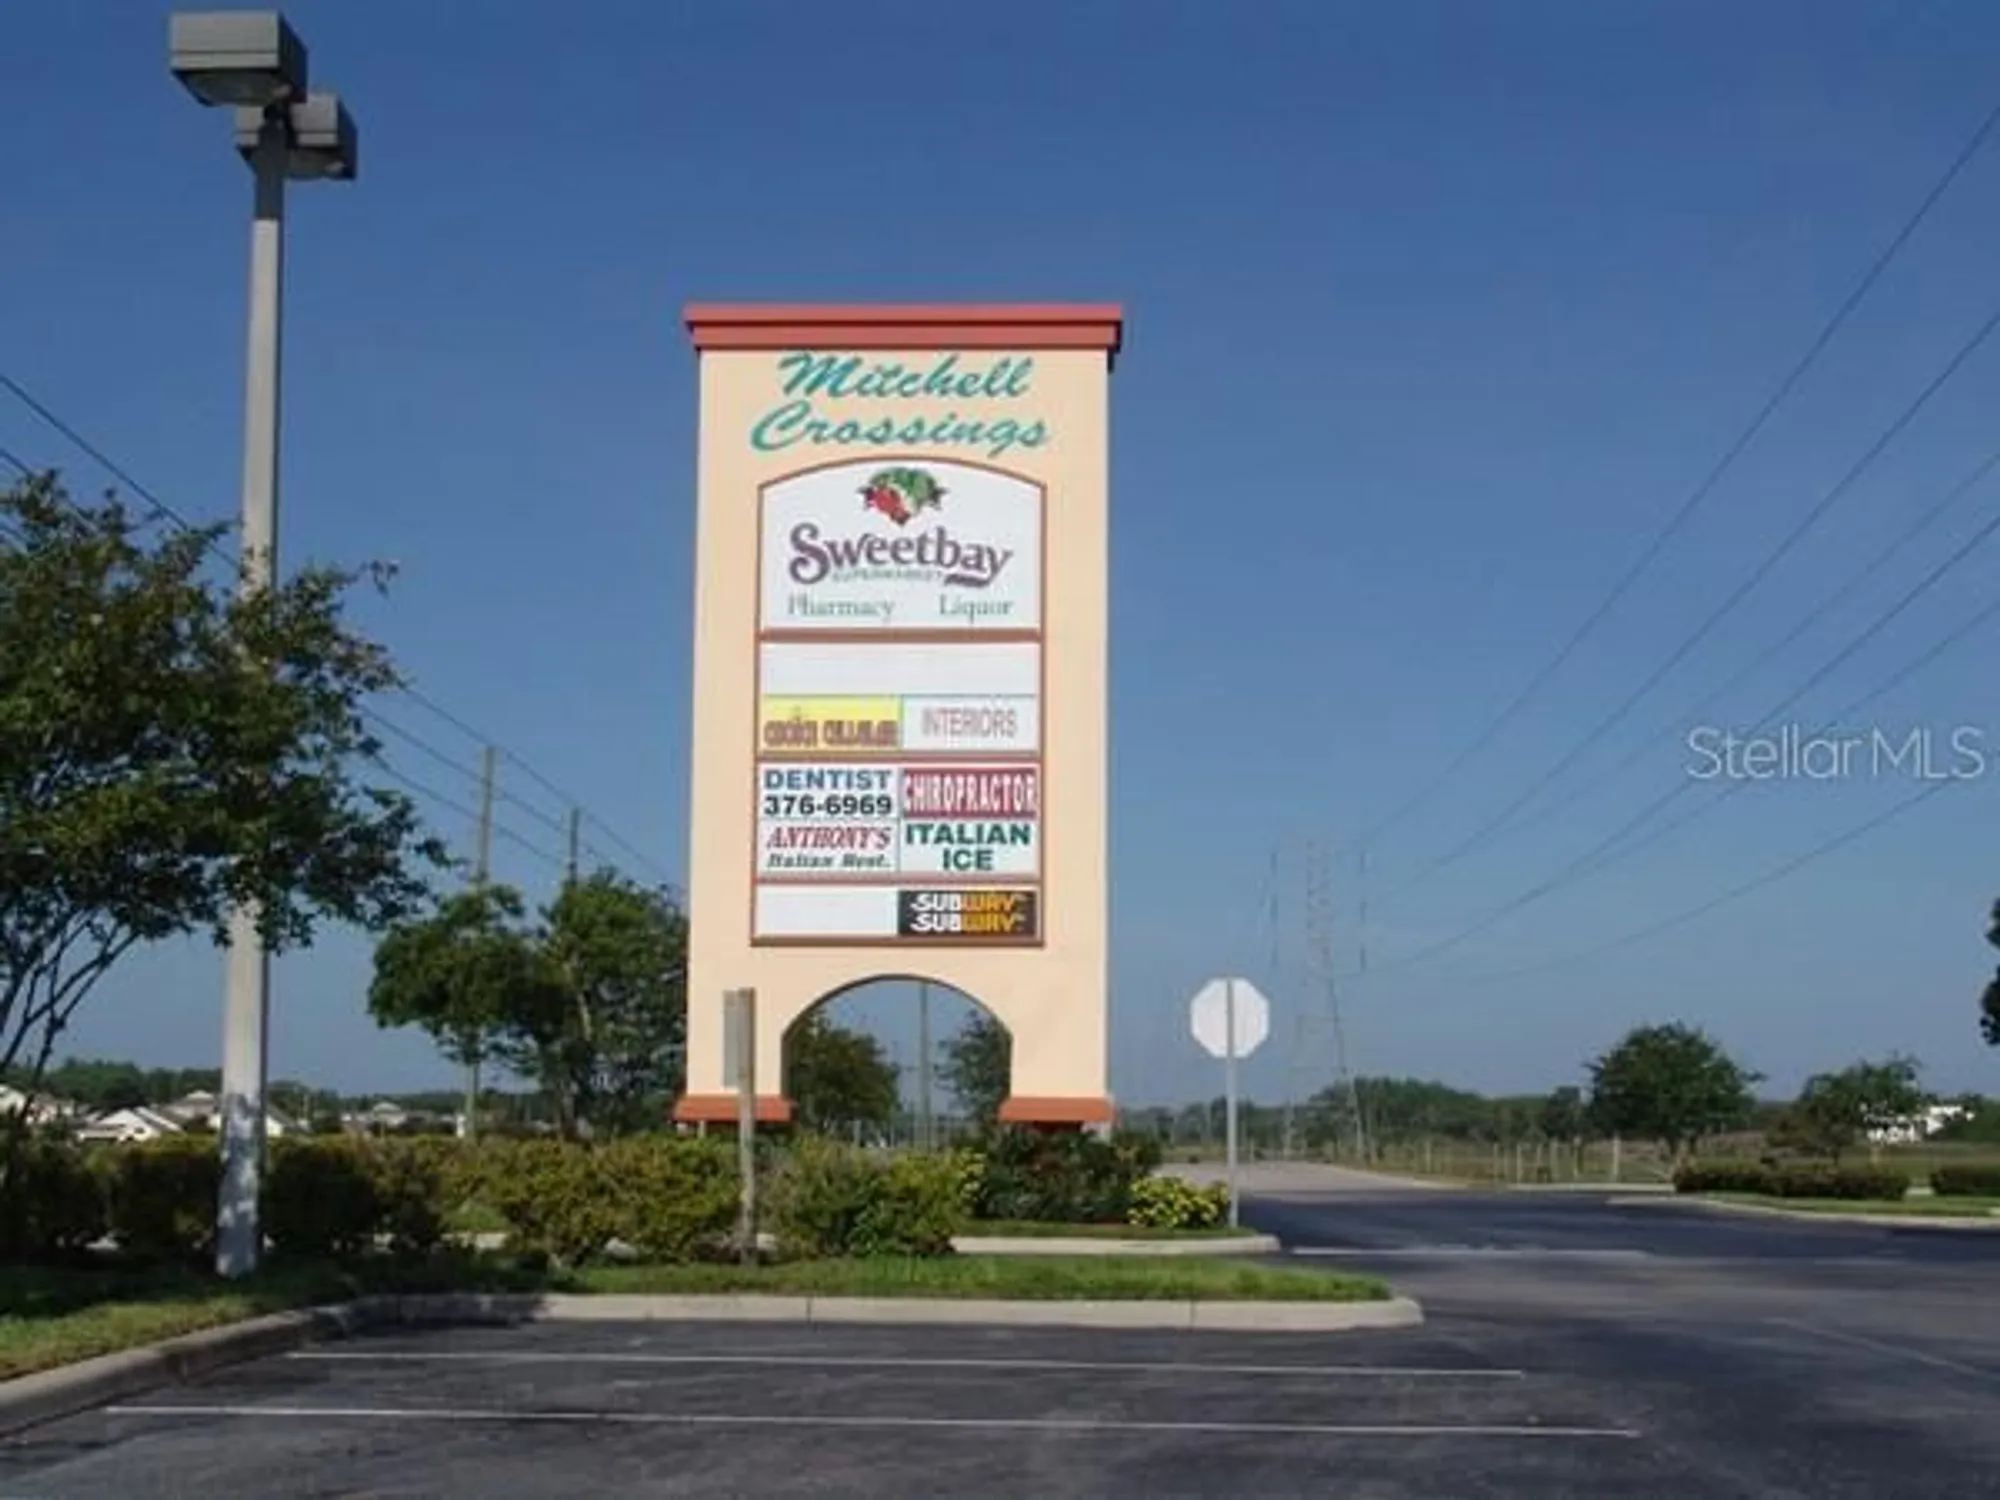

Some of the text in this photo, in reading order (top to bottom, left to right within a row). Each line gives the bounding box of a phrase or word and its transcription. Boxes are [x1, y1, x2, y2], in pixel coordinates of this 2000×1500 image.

[777, 351, 1035, 398] Mitchell
[750, 400, 1049, 457] Crossings
[788, 522, 1014, 588] Sweetbay
[788, 592, 894, 622] Pharmacy
[938, 593, 1014, 624] Liquor
[921, 706, 1019, 738] INTERIORS
[764, 769, 892, 790] DENTIST
[903, 773, 1036, 812] CHIROPRACTOR
[764, 794, 892, 816] 376-6969
[767, 826, 891, 850] ANTHONY'S
[906, 824, 1031, 845] ITALIAN
[766, 853, 835, 868] Italian
[942, 849, 994, 871] ICE
[910, 892, 1027, 912] SUBWAY
[910, 912, 1027, 932] SUBWAY
